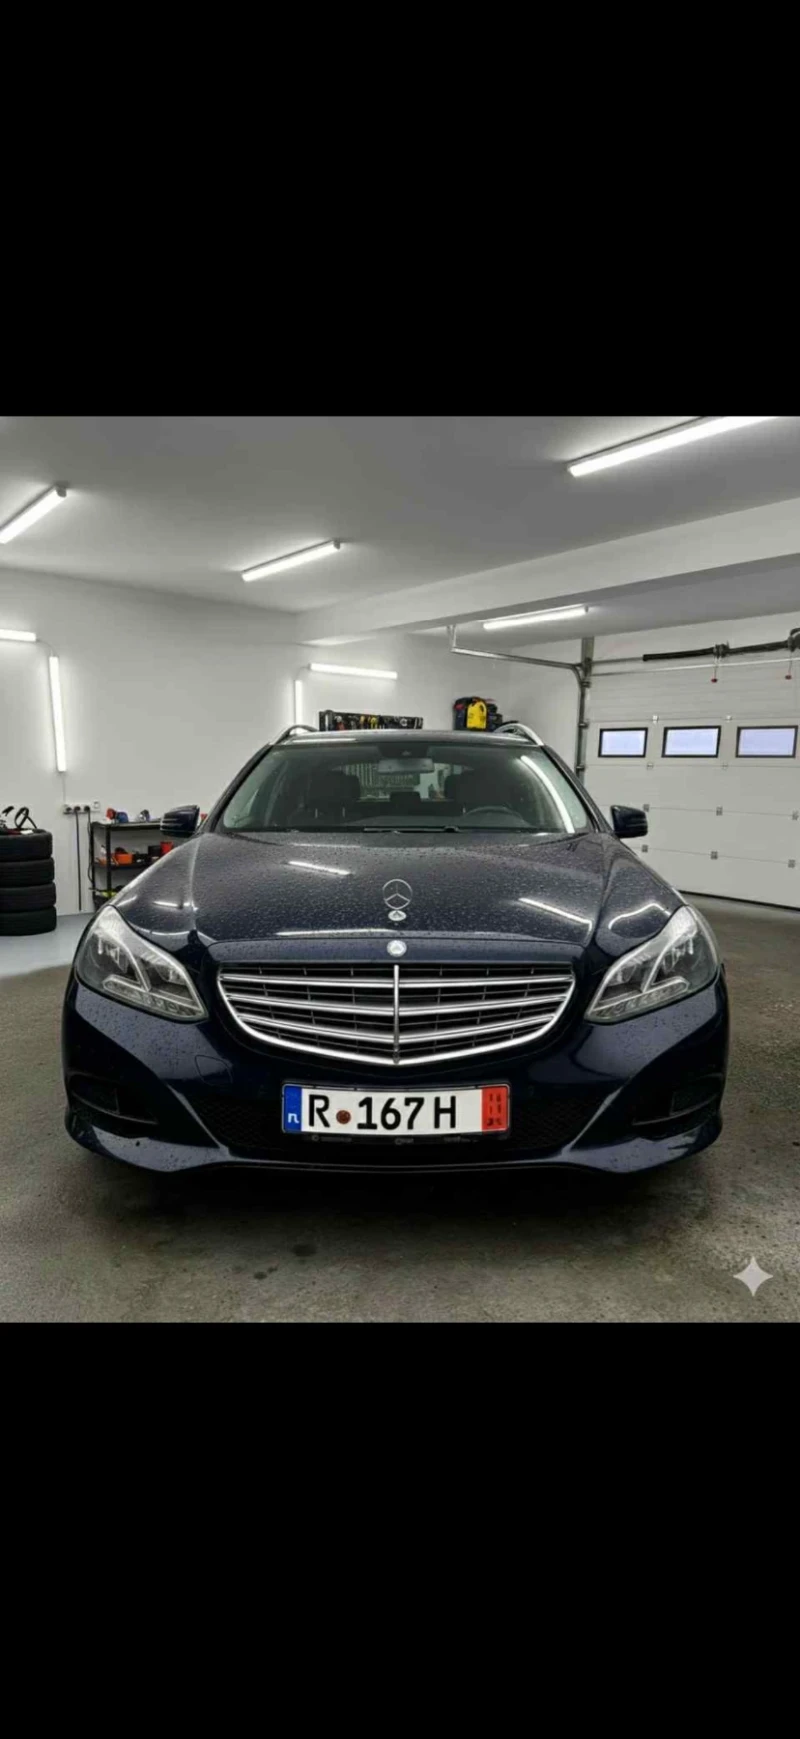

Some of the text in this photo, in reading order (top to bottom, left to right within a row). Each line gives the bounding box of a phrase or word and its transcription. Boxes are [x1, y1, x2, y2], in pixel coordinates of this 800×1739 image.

[308, 1094, 330, 1128] R
[356, 1097, 425, 1130] 167
[434, 1096, 456, 1129] H
